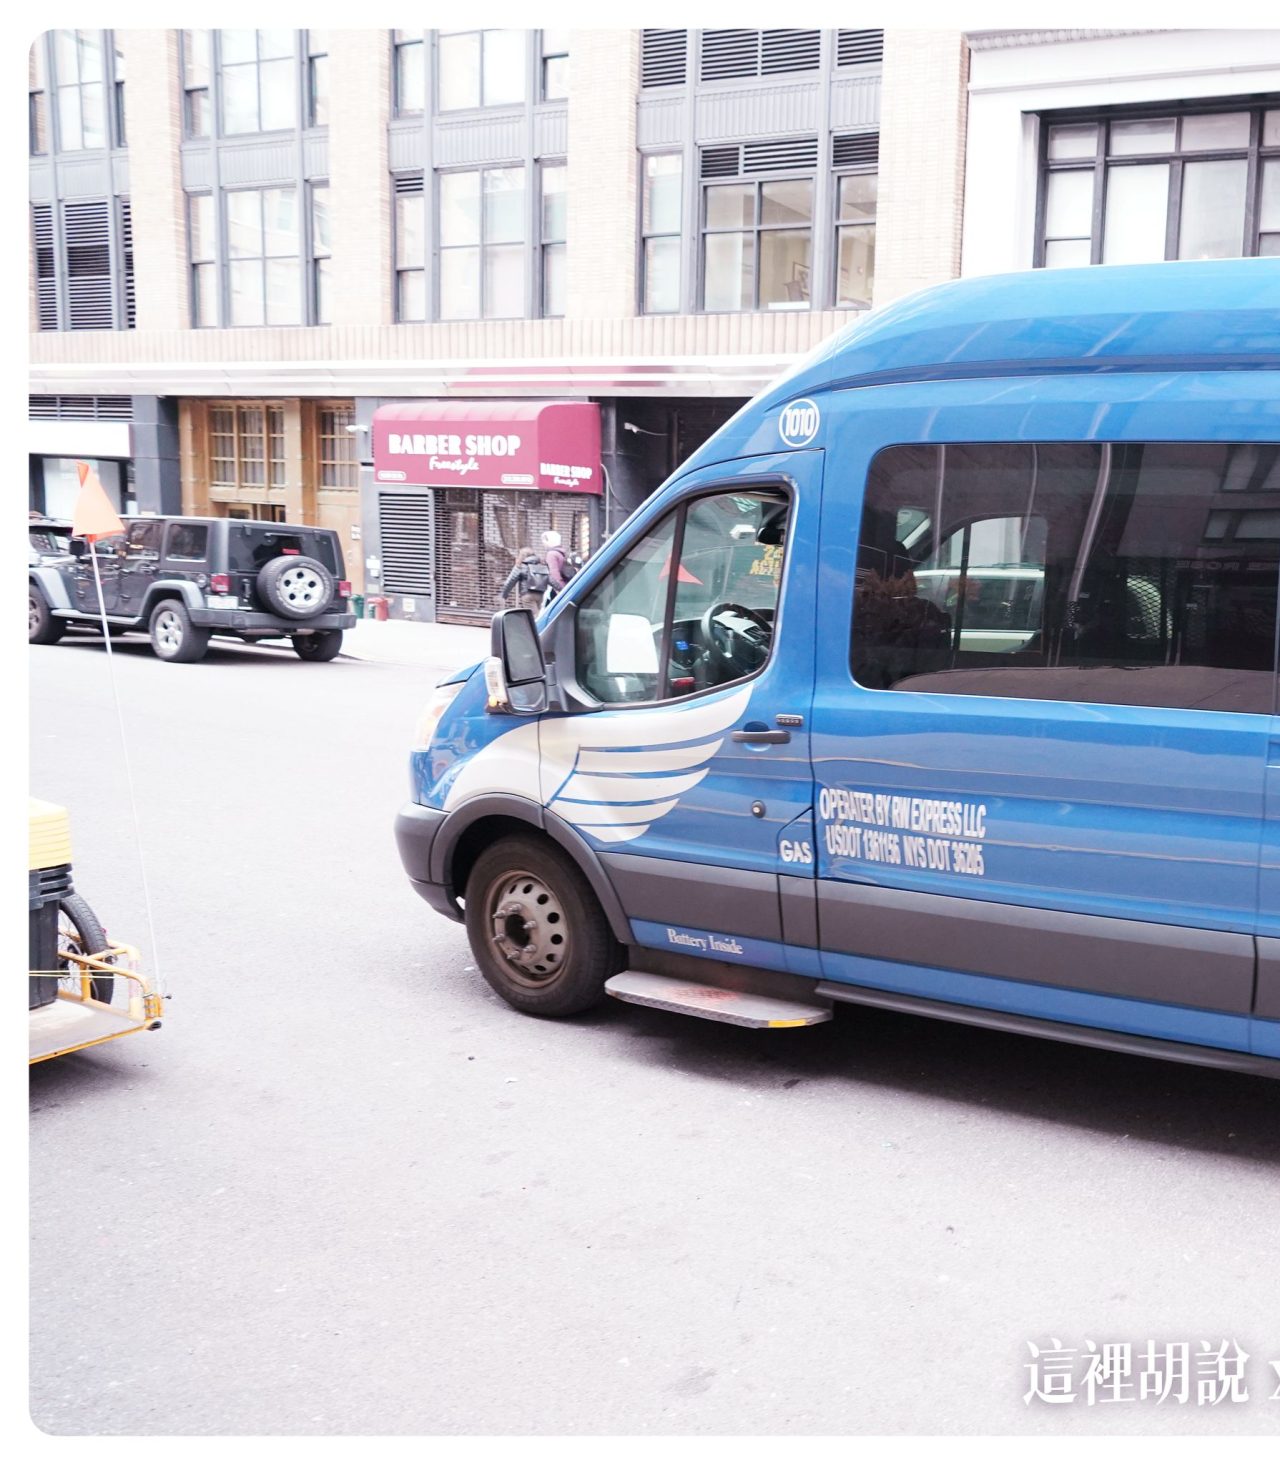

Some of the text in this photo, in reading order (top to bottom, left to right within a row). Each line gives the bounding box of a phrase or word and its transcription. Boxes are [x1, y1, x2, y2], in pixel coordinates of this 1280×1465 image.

[785, 408, 817, 437] 1010
[388, 434, 521, 456] BARBER SHOP
[429, 456, 479, 475] Freestyle
[540, 462, 592, 479] BARBER SHOP
[819, 788, 986, 838] OPERATER BY RW EXPRESS LLC
[780, 840, 813, 864] GAS
[826, 824, 862, 858] USDOT
[903, 836, 927, 868] NYS
[926, 838, 950, 871] DOT
[667, 928, 744, 954] Battery Inside
